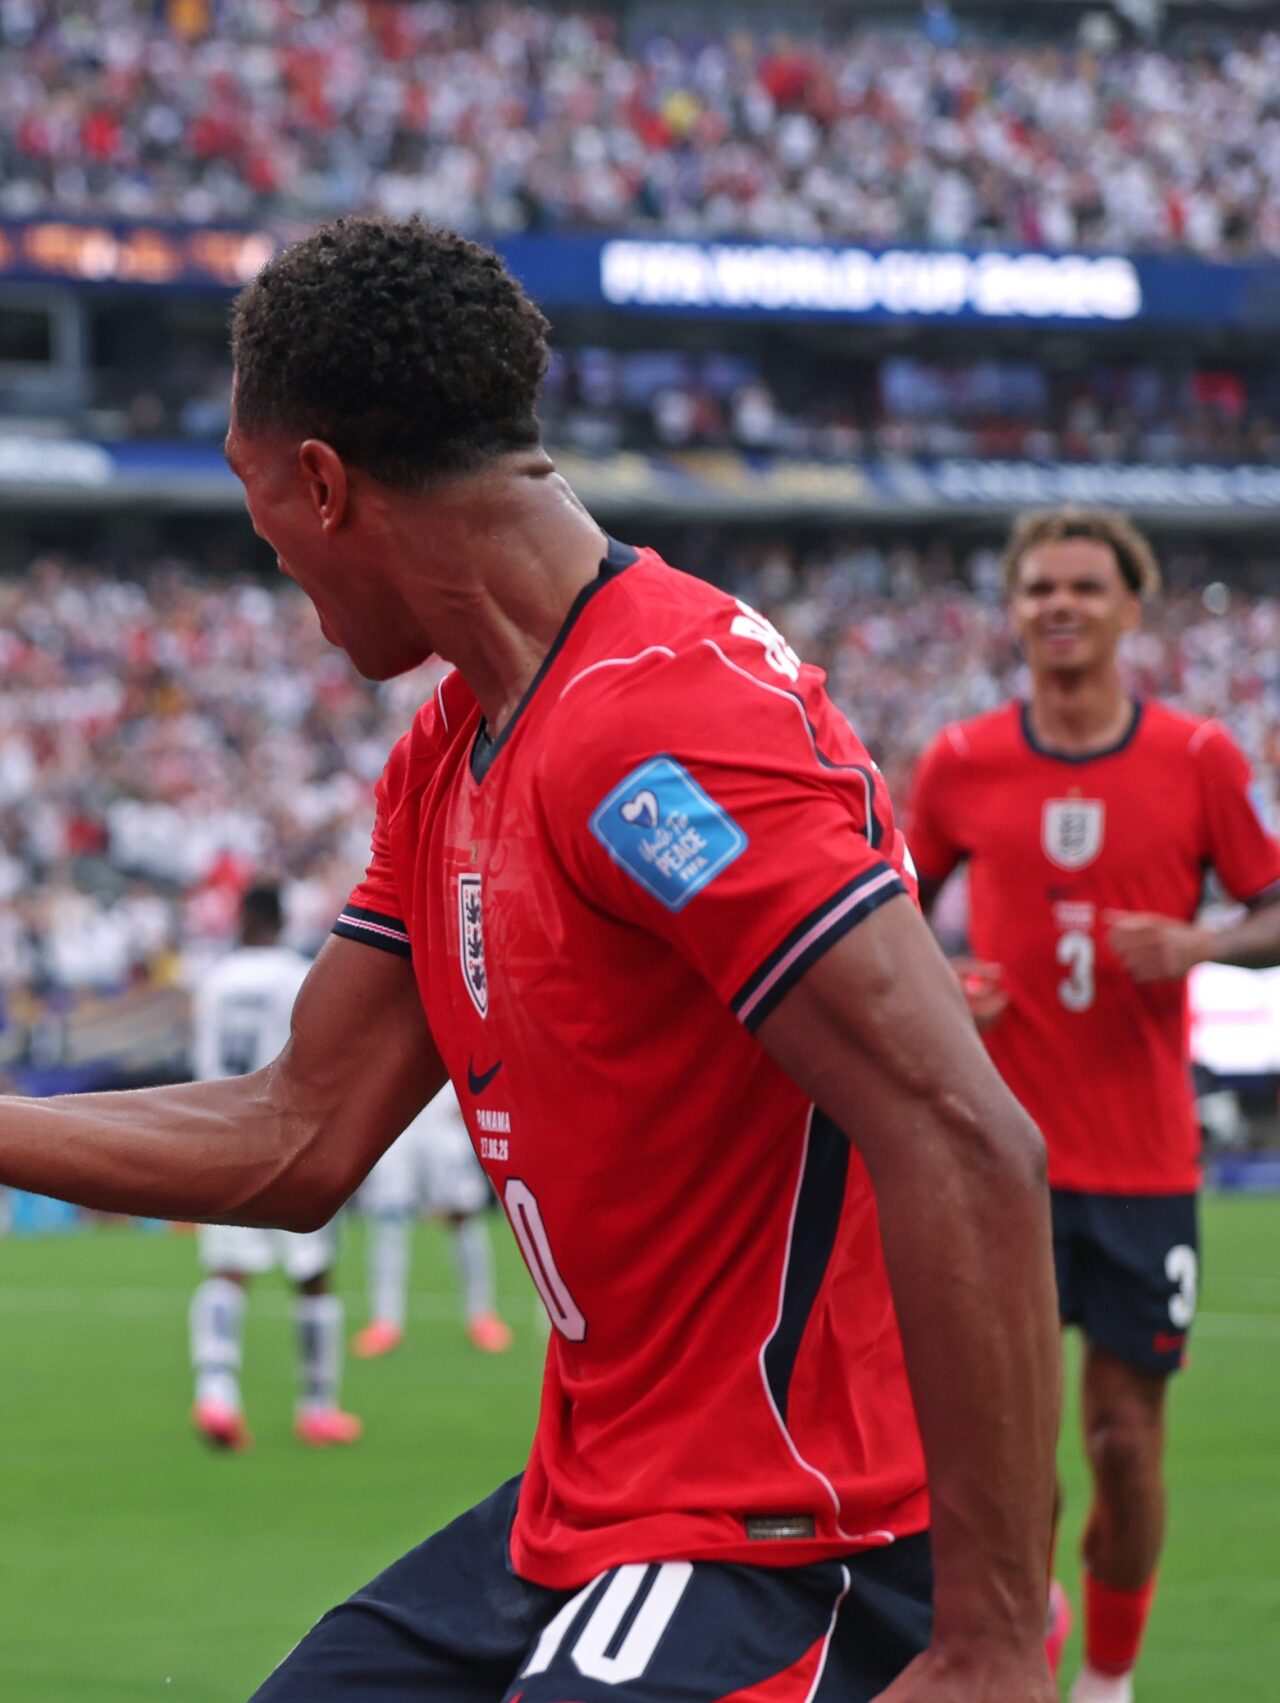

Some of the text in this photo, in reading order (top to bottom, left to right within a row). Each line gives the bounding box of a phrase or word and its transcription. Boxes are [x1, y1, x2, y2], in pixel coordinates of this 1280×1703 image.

[655, 827, 708, 878] PEACE
[1056, 930, 1096, 1012] 3
[1163, 1244, 1197, 1329] 3
[520, 1560, 695, 1686] 10
